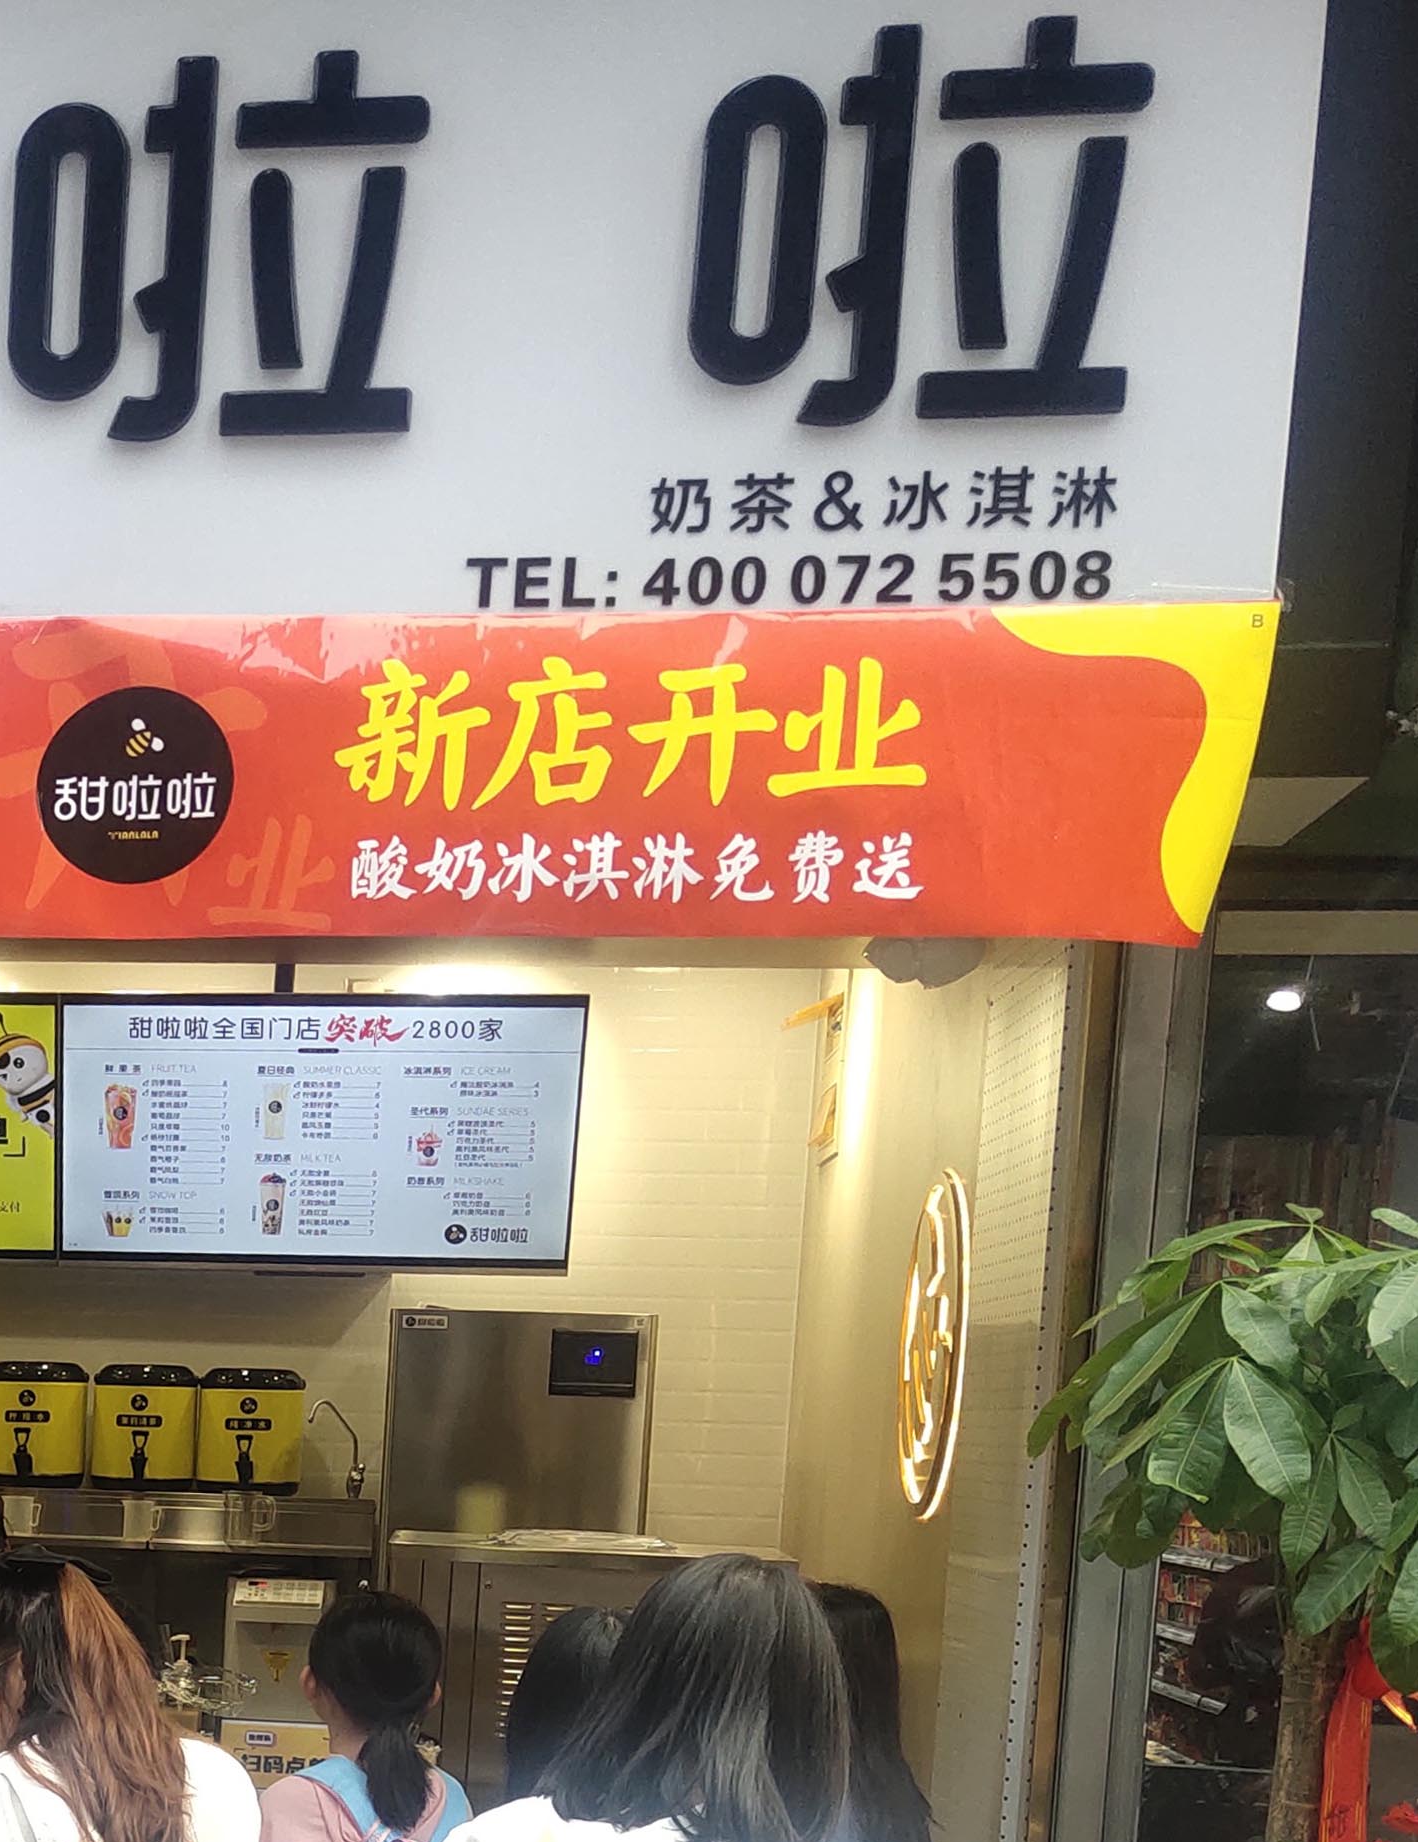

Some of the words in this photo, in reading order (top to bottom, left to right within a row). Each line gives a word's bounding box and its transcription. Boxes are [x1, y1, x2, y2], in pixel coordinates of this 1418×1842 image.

[648, 466, 1120, 536] 奶茶&冰淇淋
[466, 555, 619, 609] TEL:
[642, 556, 767, 607] 400
[790, 554, 915, 606] 072
[937, 549, 1113, 605] 5508
[334, 656, 927, 811] 新店开业
[54, 772, 217, 821] 甜啦啦
[350, 830, 924, 903] 酸奶冰淇淋免费送
[151, 1064, 176, 1073] FRUIT
[179, 1064, 197, 1073] TEA
[301, 1153, 323, 1163] MILK
[325, 1153, 342, 1163] TEA
[179, 1191, 198, 1200] TOP
[470, 1227, 529, 1243] 甜啦啦
[241, 1754, 326, 1774] 扫码点
